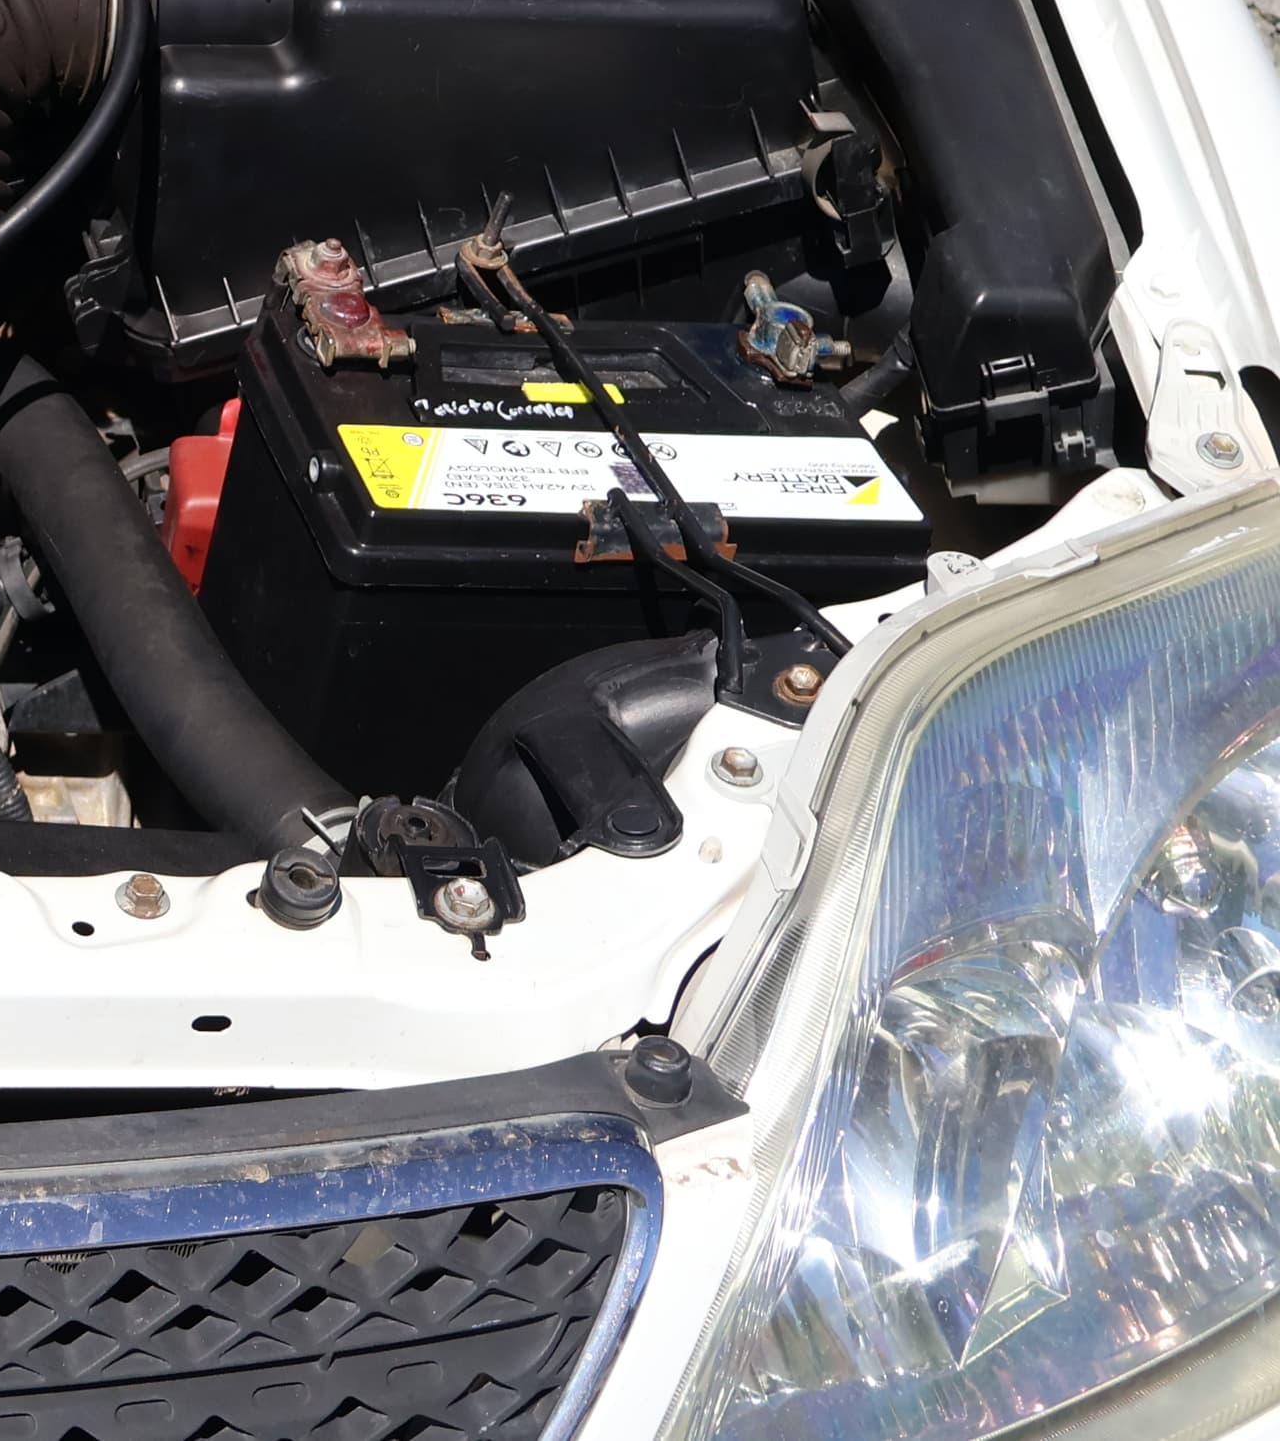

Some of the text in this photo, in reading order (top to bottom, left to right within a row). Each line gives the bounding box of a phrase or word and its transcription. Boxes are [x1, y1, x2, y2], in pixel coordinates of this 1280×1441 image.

[448, 465, 556, 475] TECHNOLOGY
[732, 472, 840, 484] BATTERY
[780, 483, 847, 494] FIRST
[442, 492, 528, 507] 636C
